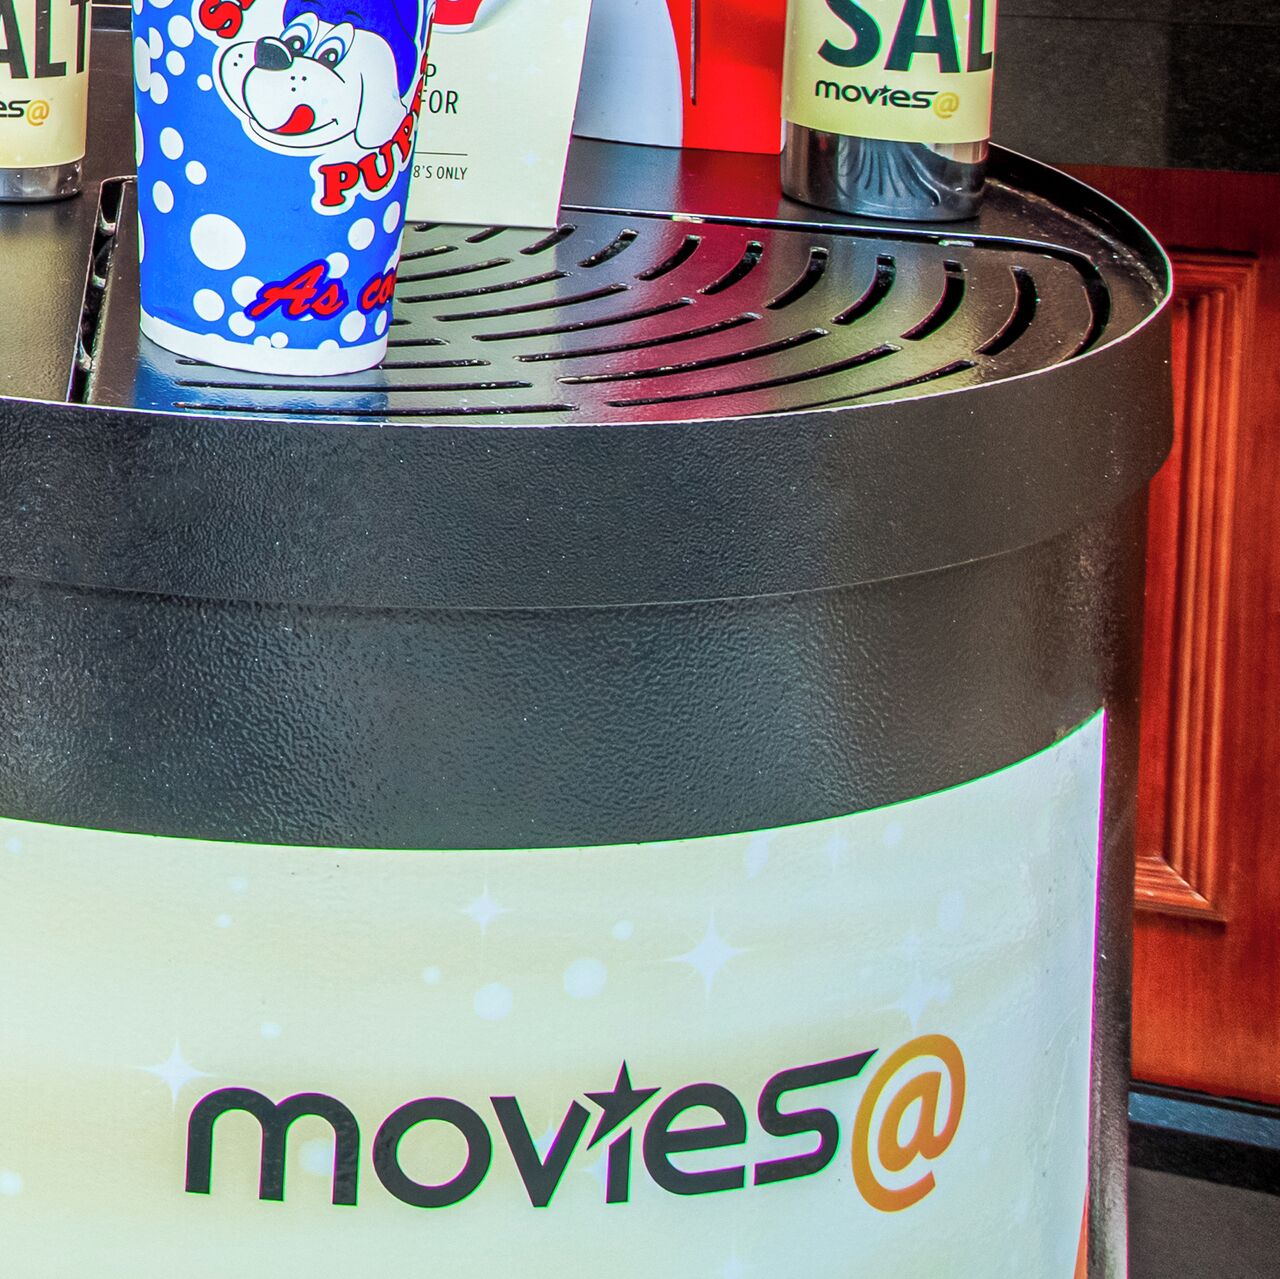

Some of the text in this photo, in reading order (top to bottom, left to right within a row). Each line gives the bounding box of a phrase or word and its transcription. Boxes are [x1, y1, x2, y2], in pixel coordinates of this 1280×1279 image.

[814, 79, 960, 119] movies@
[436, 166, 468, 180] ONLY
[250, 264, 343, 316] As
[183, 1033, 967, 1214] movies@
